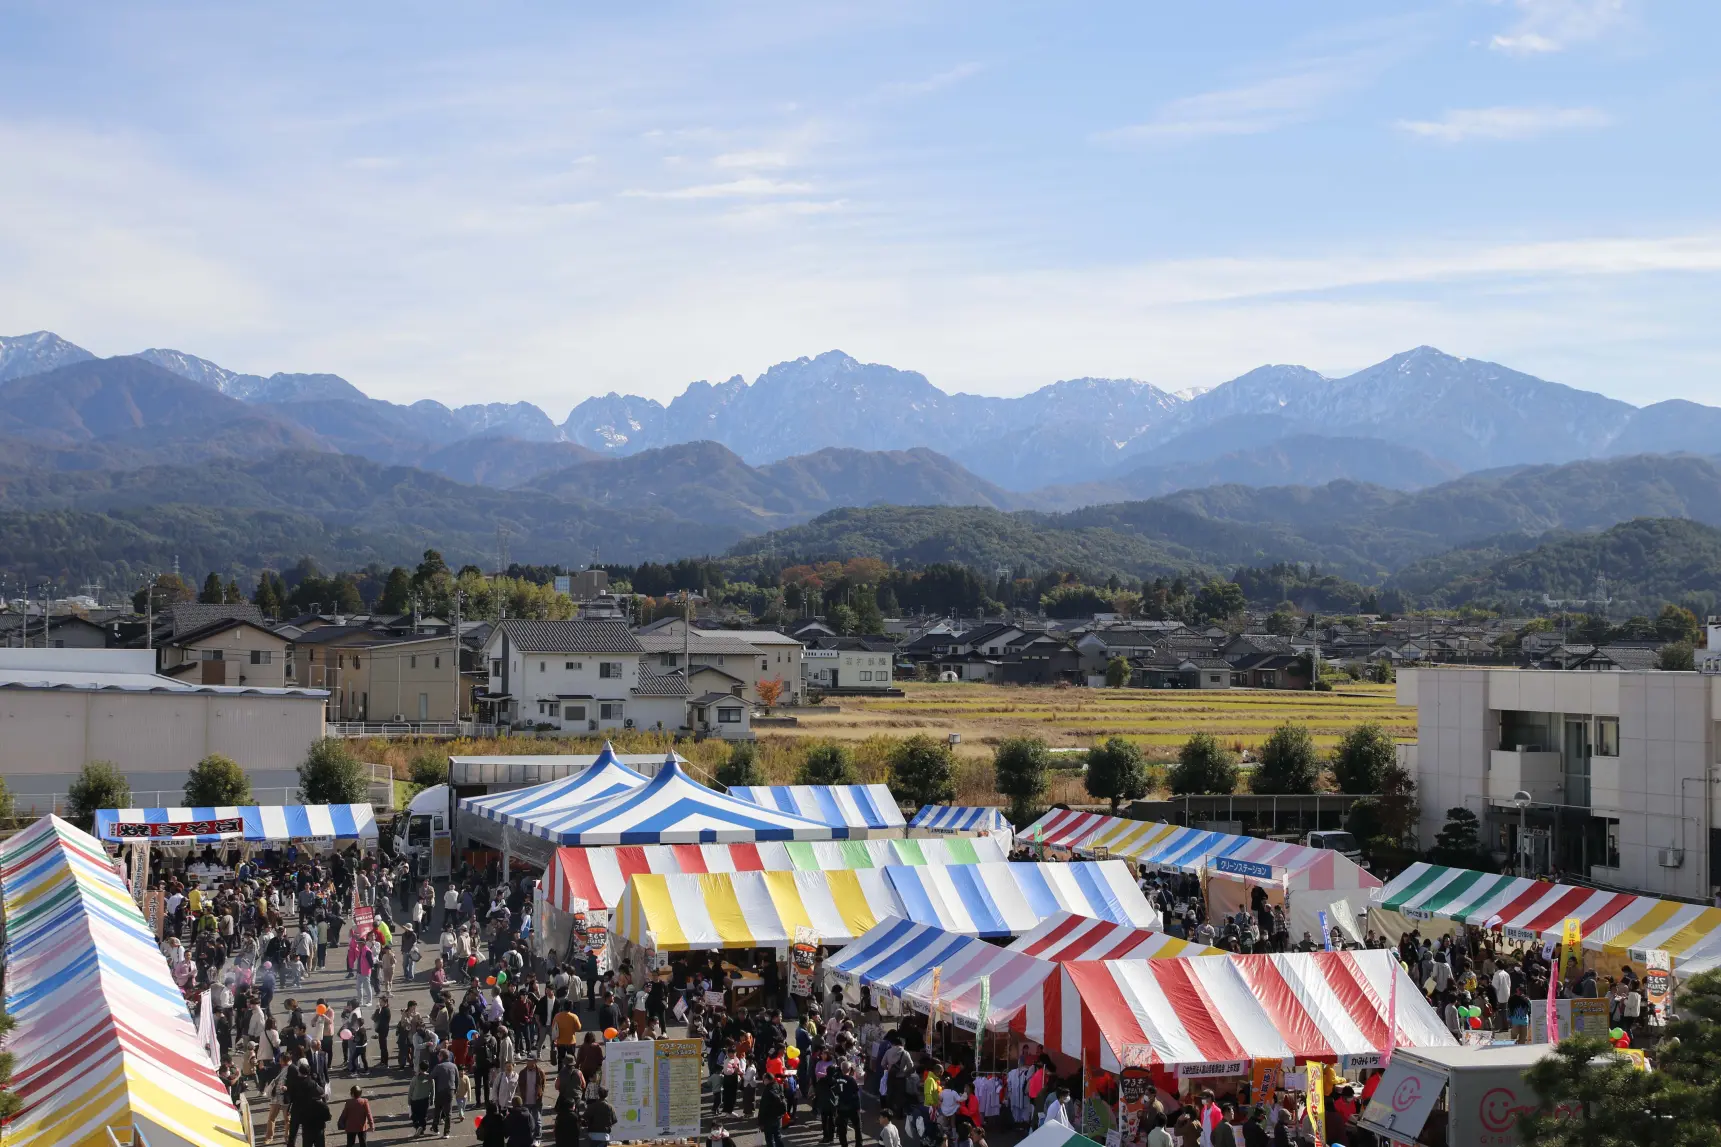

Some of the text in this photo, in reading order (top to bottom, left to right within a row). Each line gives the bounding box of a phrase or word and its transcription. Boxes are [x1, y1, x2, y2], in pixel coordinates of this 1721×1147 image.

[1221, 860, 1267, 875] クリーンステーション
